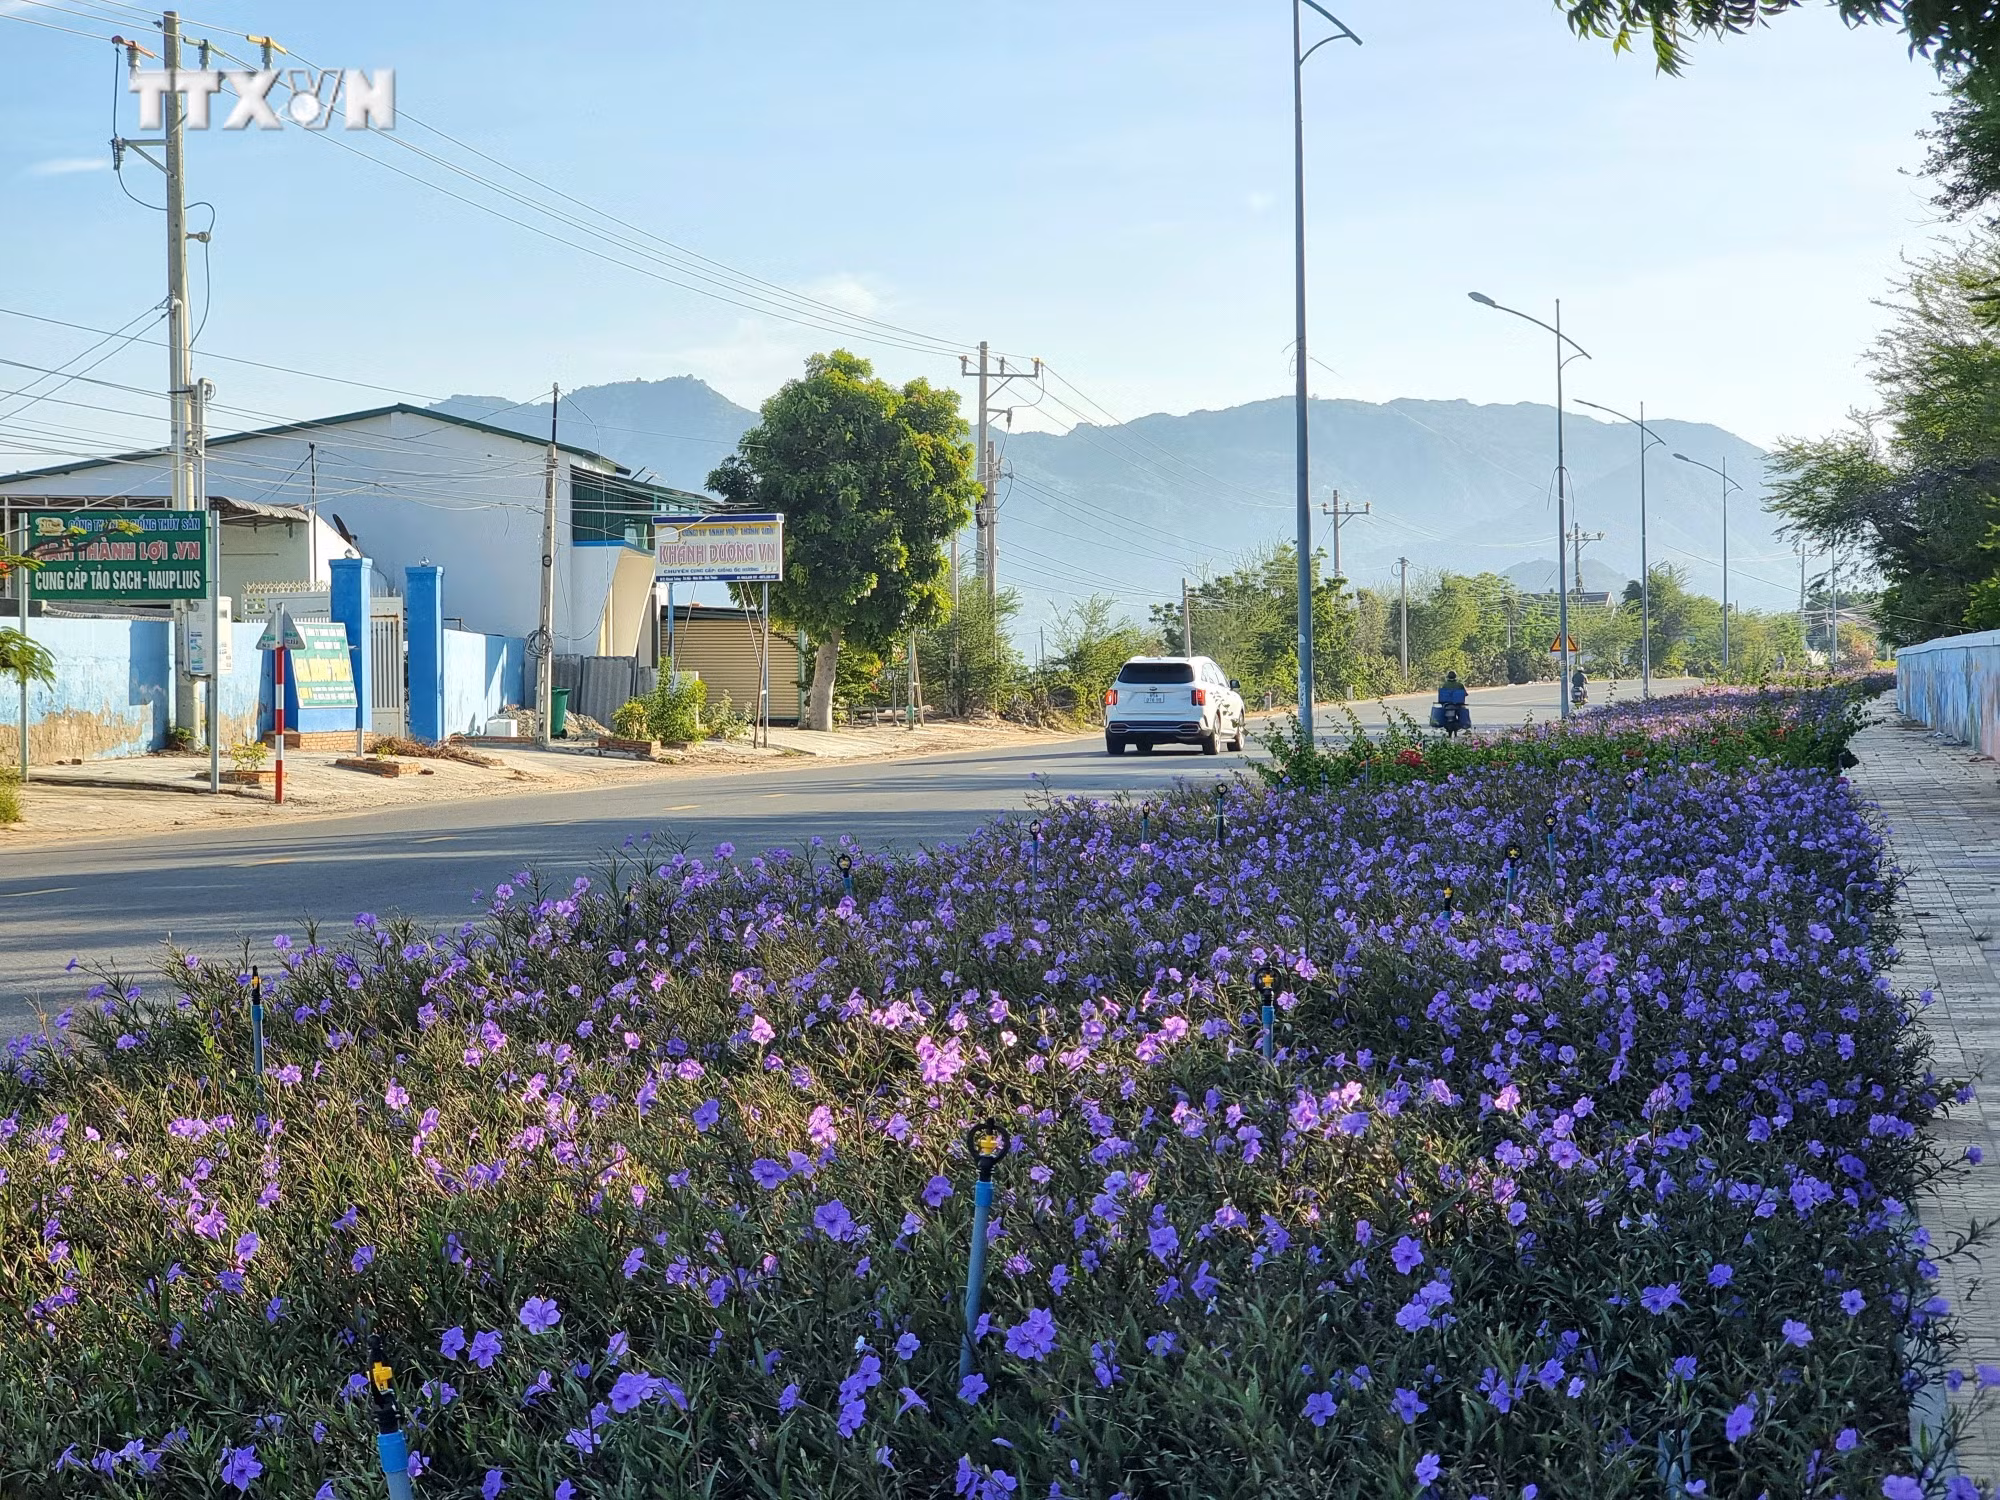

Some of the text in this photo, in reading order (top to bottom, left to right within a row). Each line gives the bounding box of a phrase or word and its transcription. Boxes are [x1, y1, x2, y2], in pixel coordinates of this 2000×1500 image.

[68, 516, 92, 531] CÔNG
[93, 519, 104, 531] TY
[158, 514, 180, 531] THỦY
[182, 514, 200, 531] SẢN
[139, 540, 168, 565] LỢI
[758, 543, 777, 563] VN
[35, 570, 65, 591] CUNG
[66, 564, 88, 591] CẤP
[90, 564, 110, 590] TẢO
